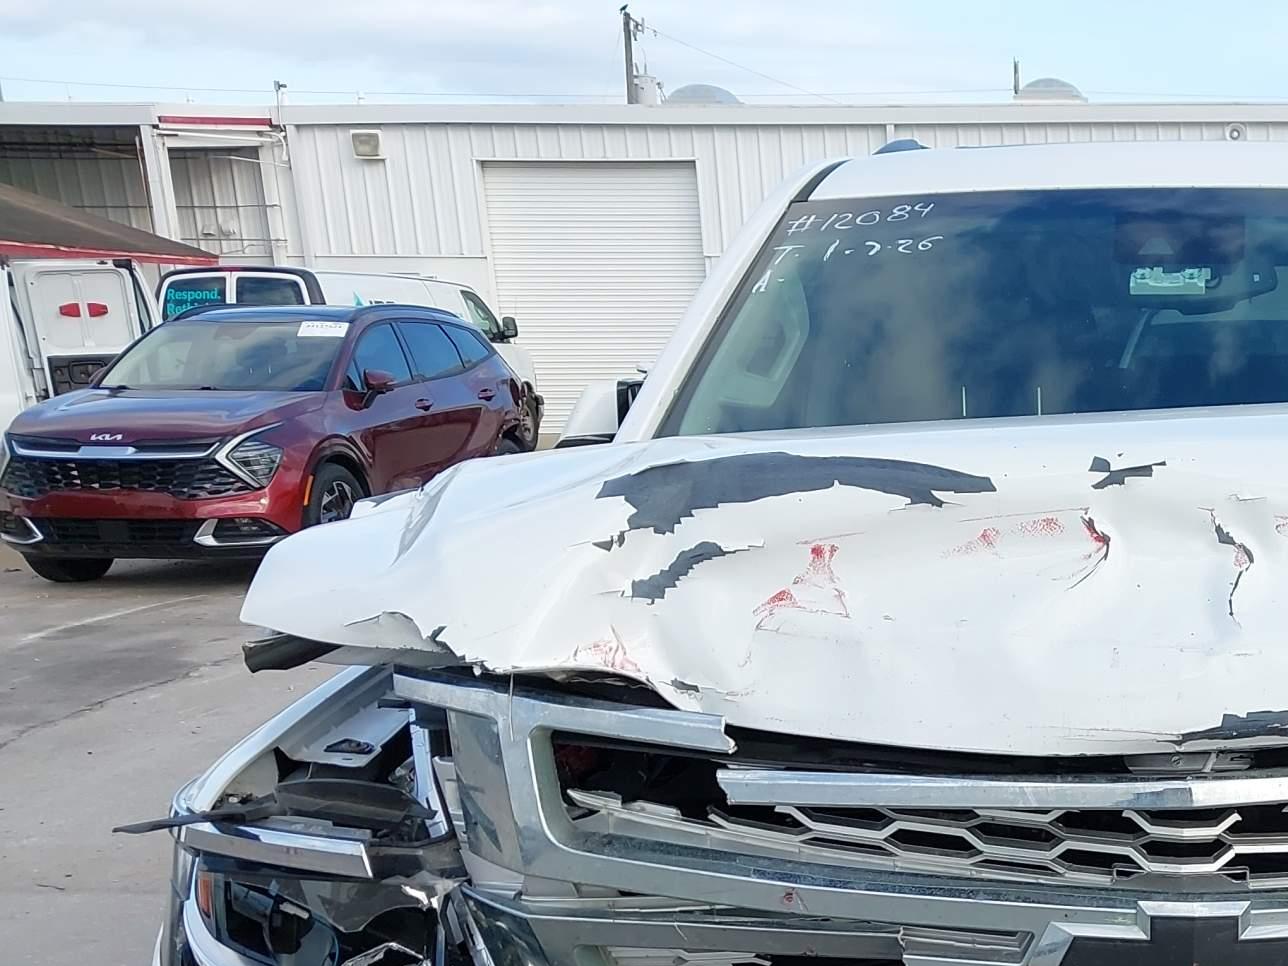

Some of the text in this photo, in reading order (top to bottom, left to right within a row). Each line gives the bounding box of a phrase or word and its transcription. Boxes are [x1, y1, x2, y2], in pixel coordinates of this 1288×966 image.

[786, 202, 935, 237] #12084
[166, 287, 222, 302] Respond.
[90, 433, 123, 441] KIA
